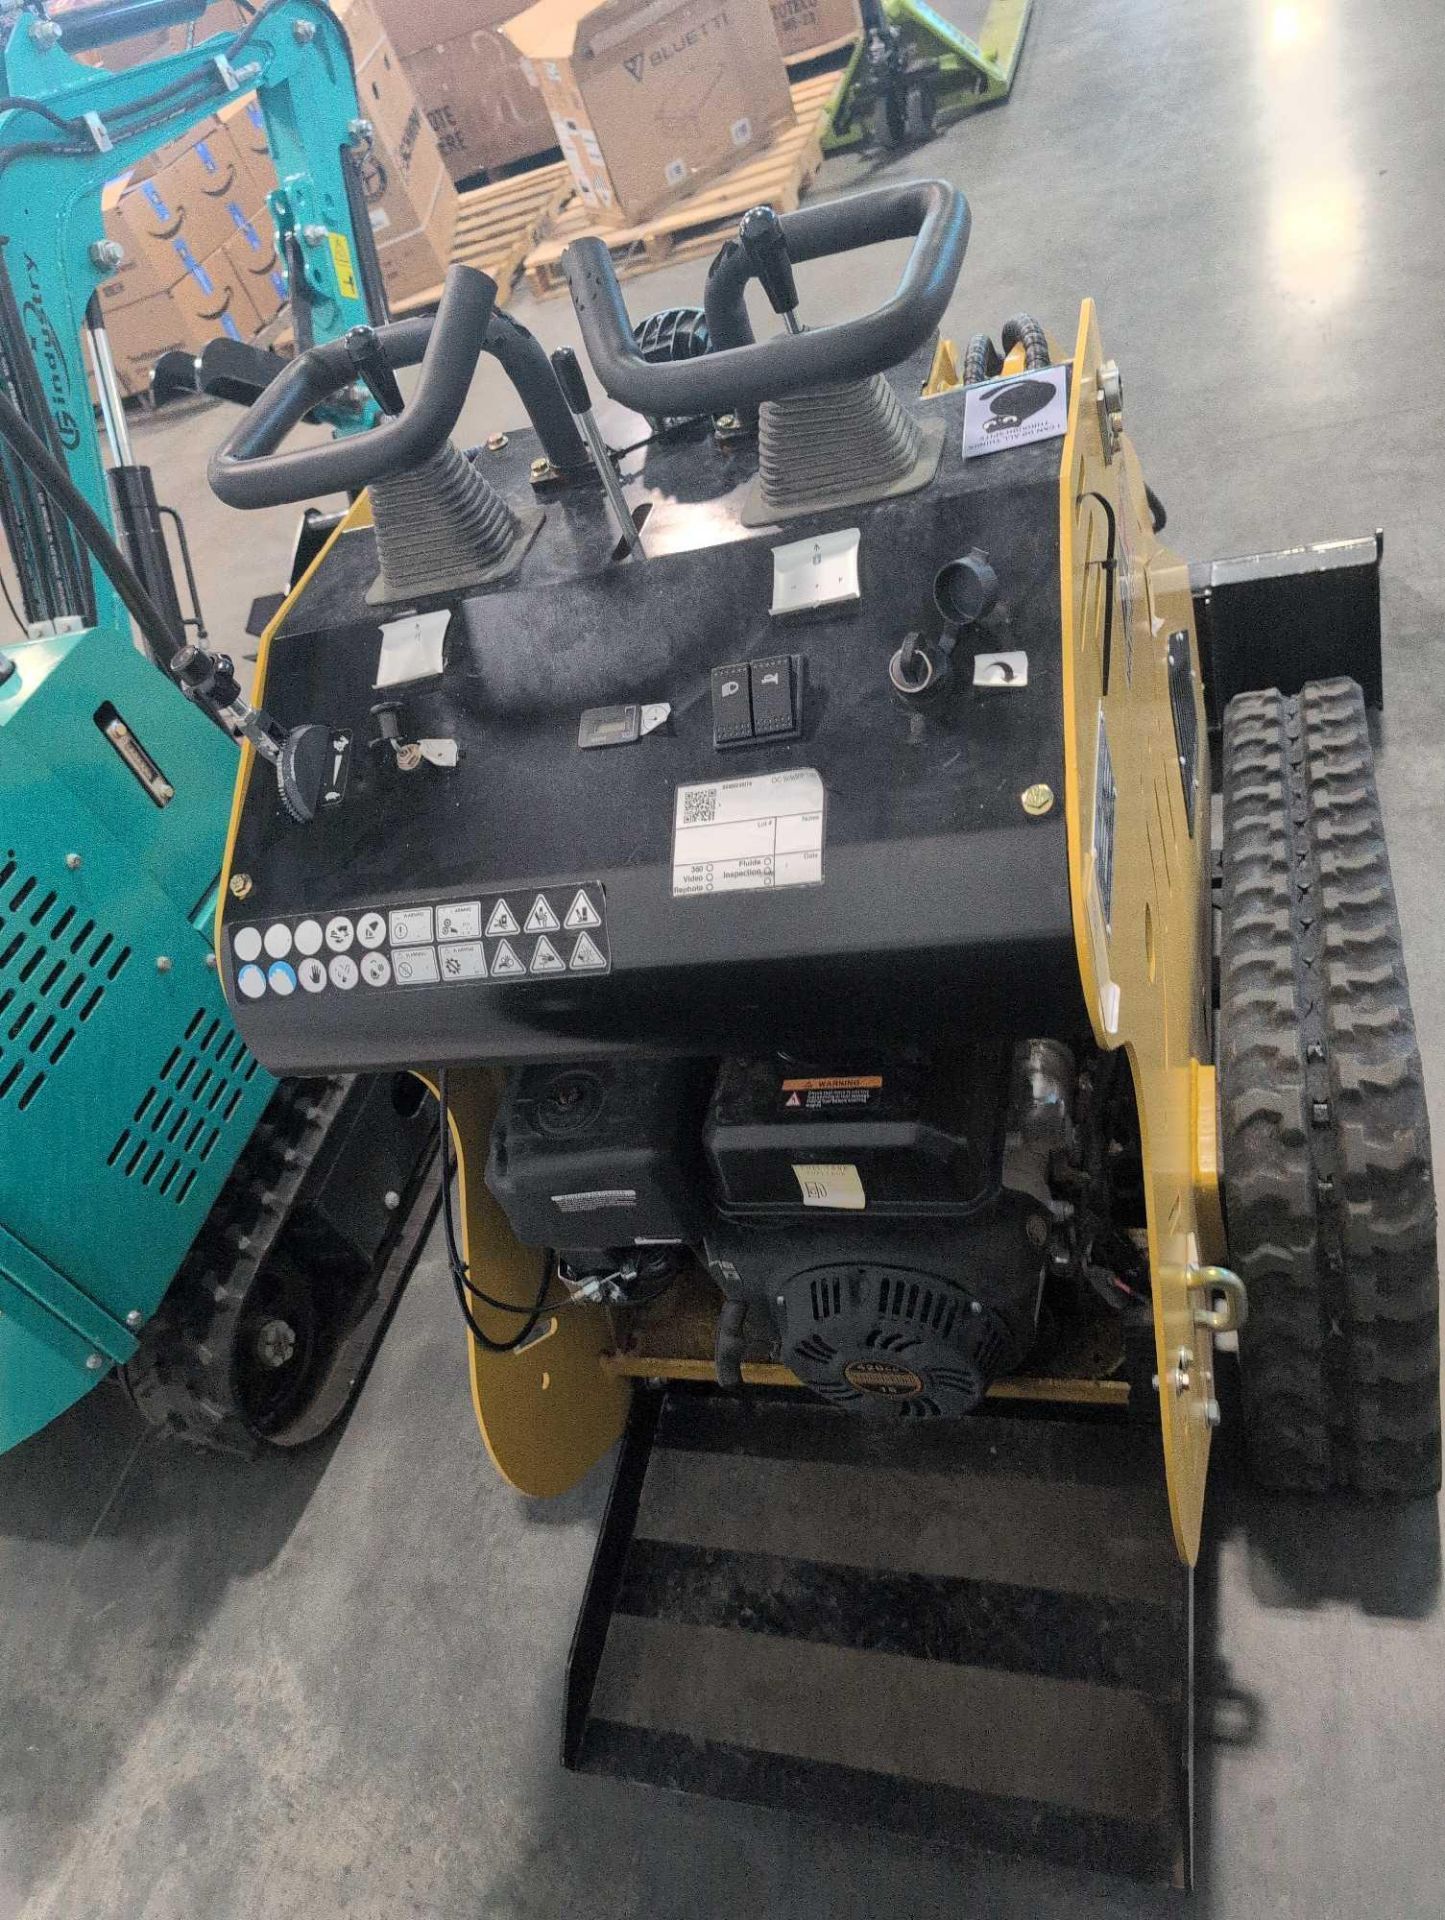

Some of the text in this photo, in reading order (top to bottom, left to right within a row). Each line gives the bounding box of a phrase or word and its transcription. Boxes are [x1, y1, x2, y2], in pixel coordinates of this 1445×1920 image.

[649, 12, 729, 67] BLUETTI
[683, 875, 703, 883] Video
[818, 1078, 868, 1088] WARNING
